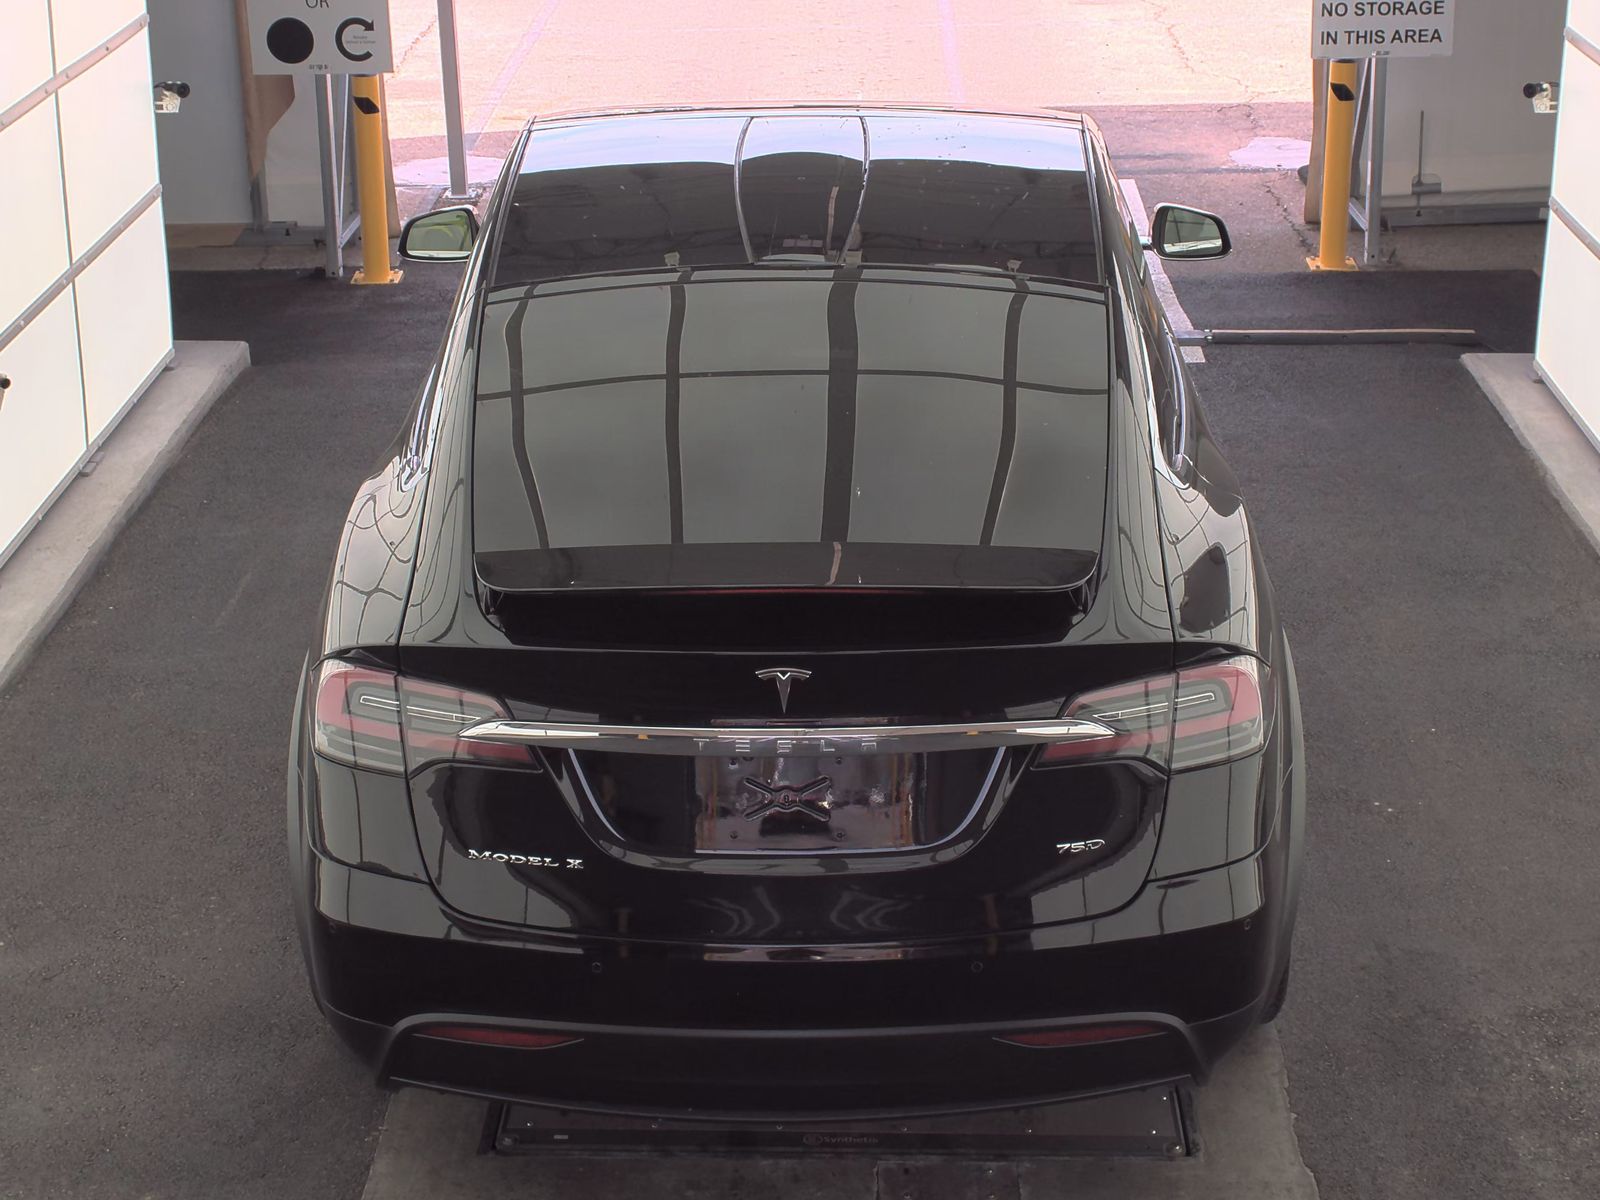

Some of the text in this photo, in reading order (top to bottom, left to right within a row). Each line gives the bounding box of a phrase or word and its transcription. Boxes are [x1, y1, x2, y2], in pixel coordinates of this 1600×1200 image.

[1321, 0, 1445, 17] NO STORAGE
[1320, 28, 1443, 45] IN THIS AREA
[693, 738, 877, 753] TESLA
[1056, 838, 1106, 854] 75D
[468, 849, 584, 869] MODEL X
